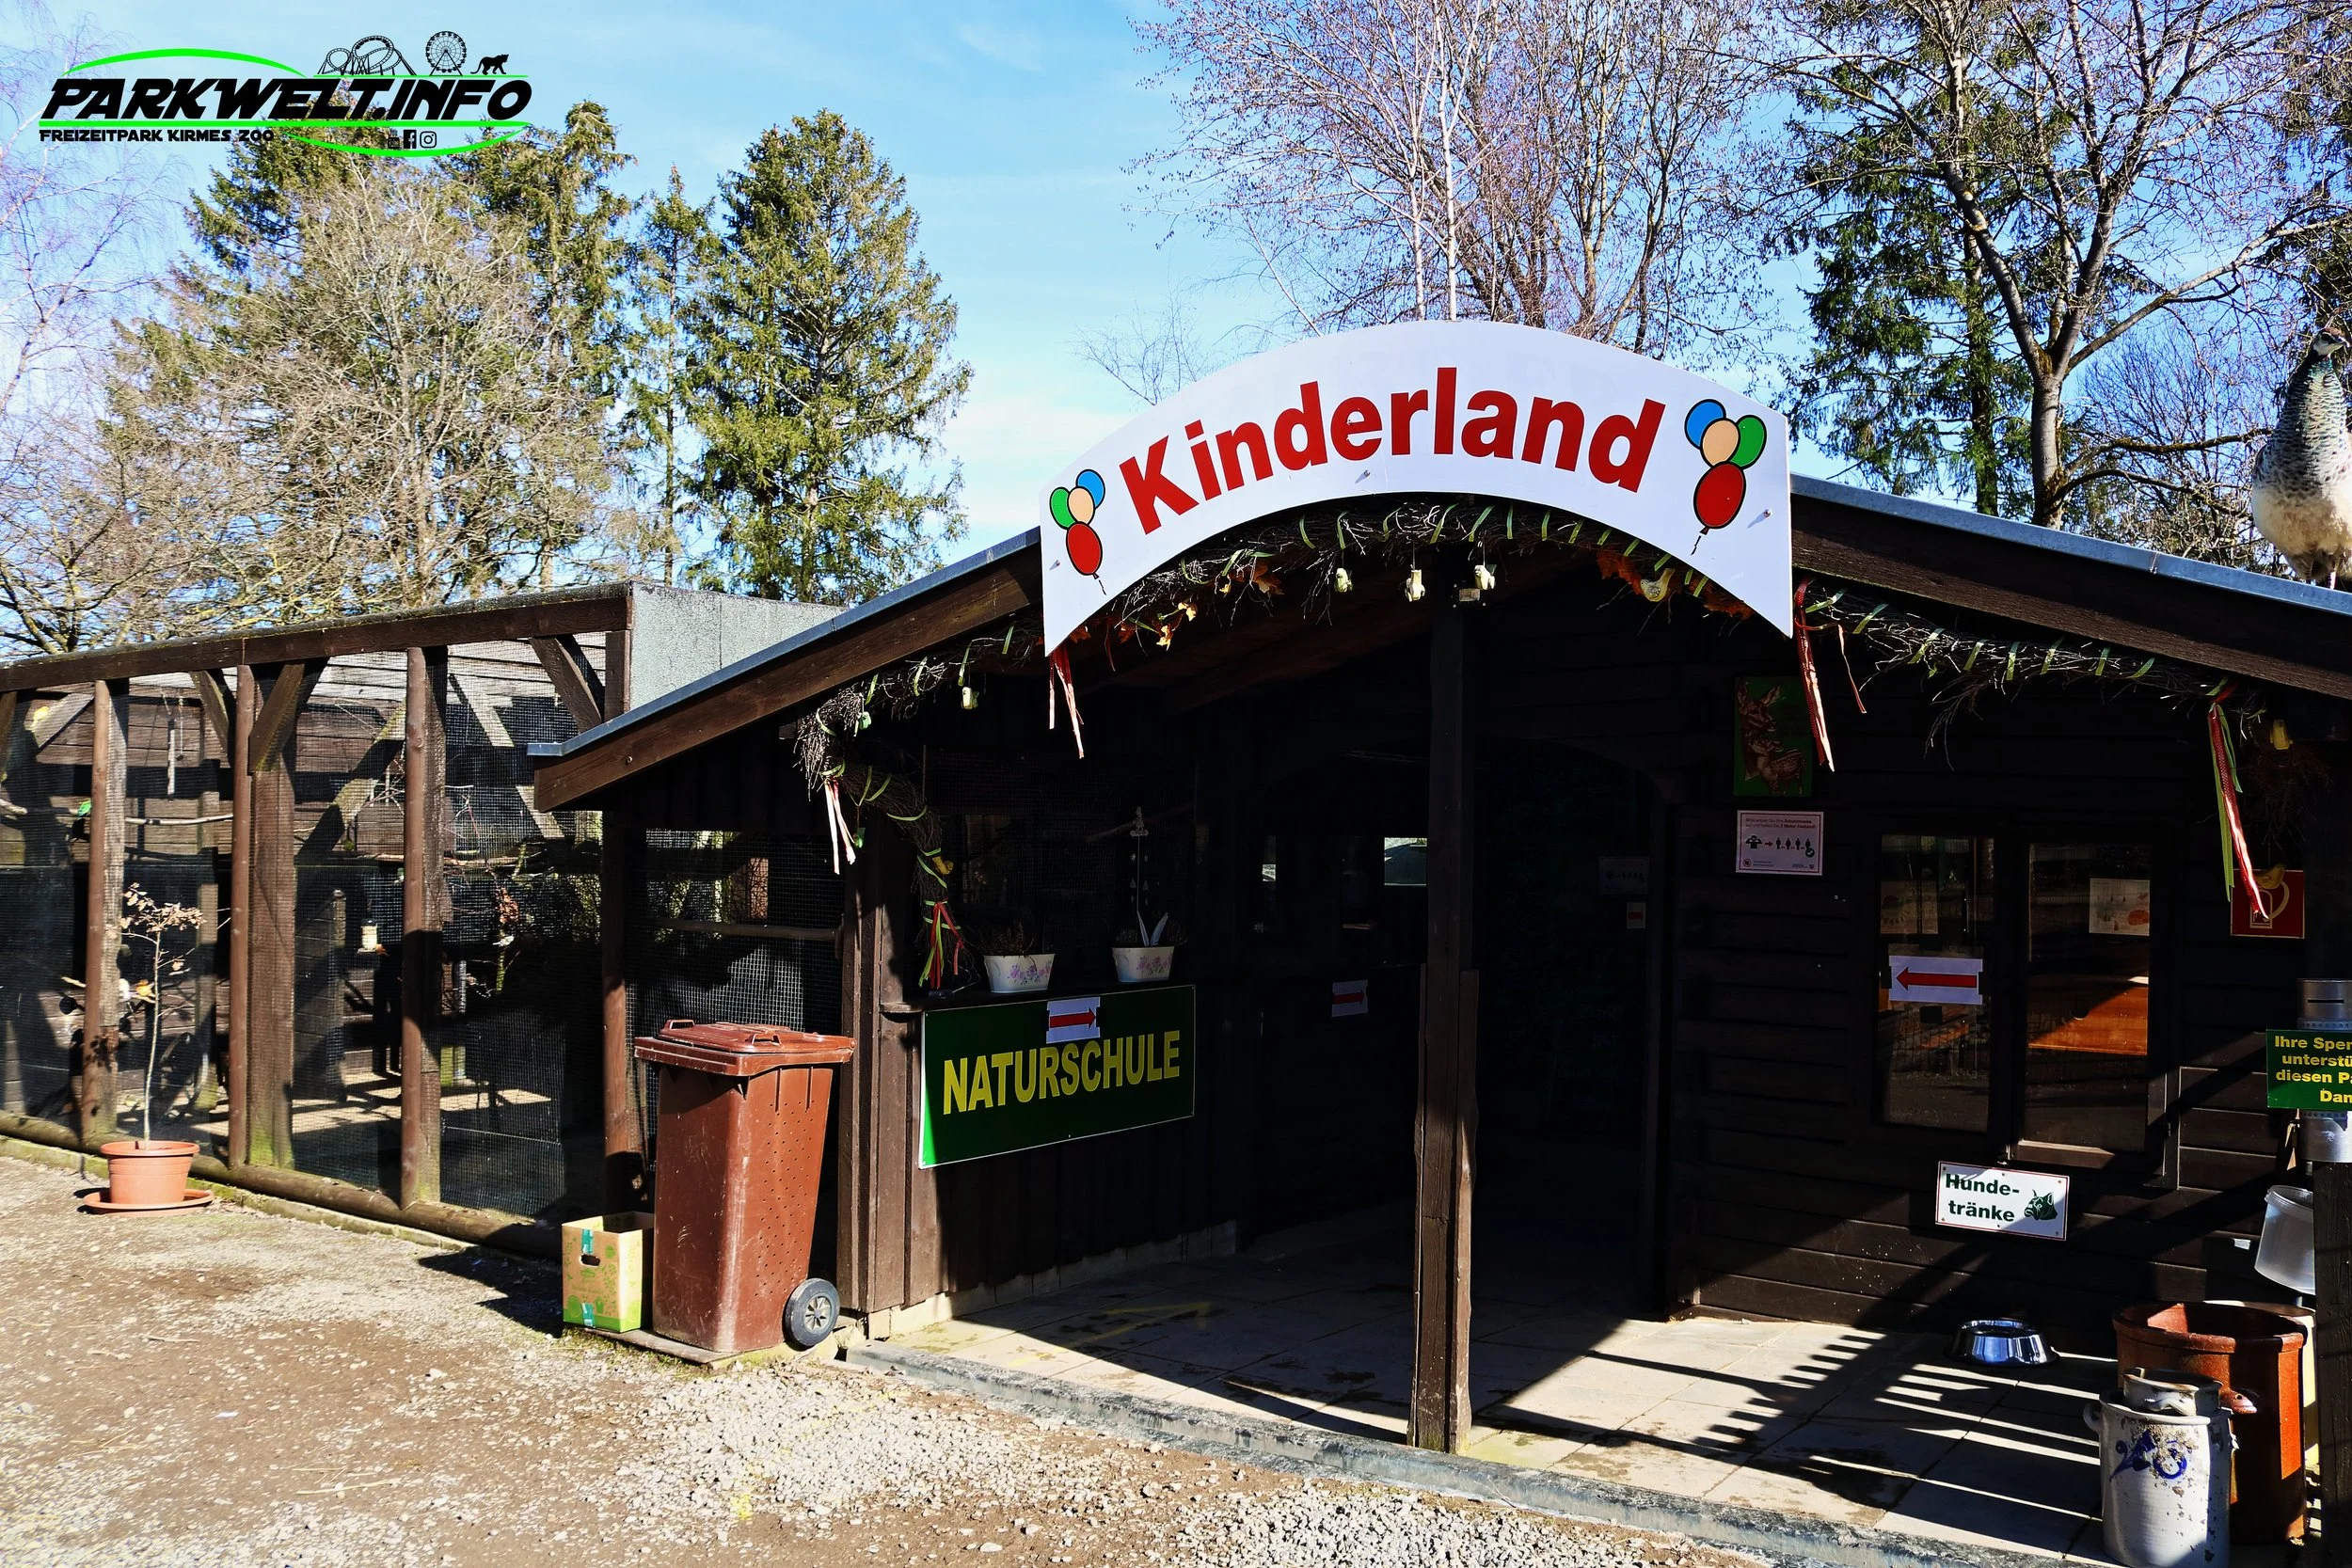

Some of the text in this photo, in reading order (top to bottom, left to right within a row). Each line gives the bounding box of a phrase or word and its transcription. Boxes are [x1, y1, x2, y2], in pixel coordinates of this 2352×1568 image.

[1119, 366, 1665, 535] Kinderland
[2275, 1036, 2308, 1048] Ihre
[943, 1030, 1181, 1116] NATURSCHULE
[2276, 1069, 2332, 1083] diesen
[2320, 1089, 2352, 1103] Dan
[1946, 1173, 2020, 1196] Hunde-
[1947, 1200, 2015, 1222] tränke
